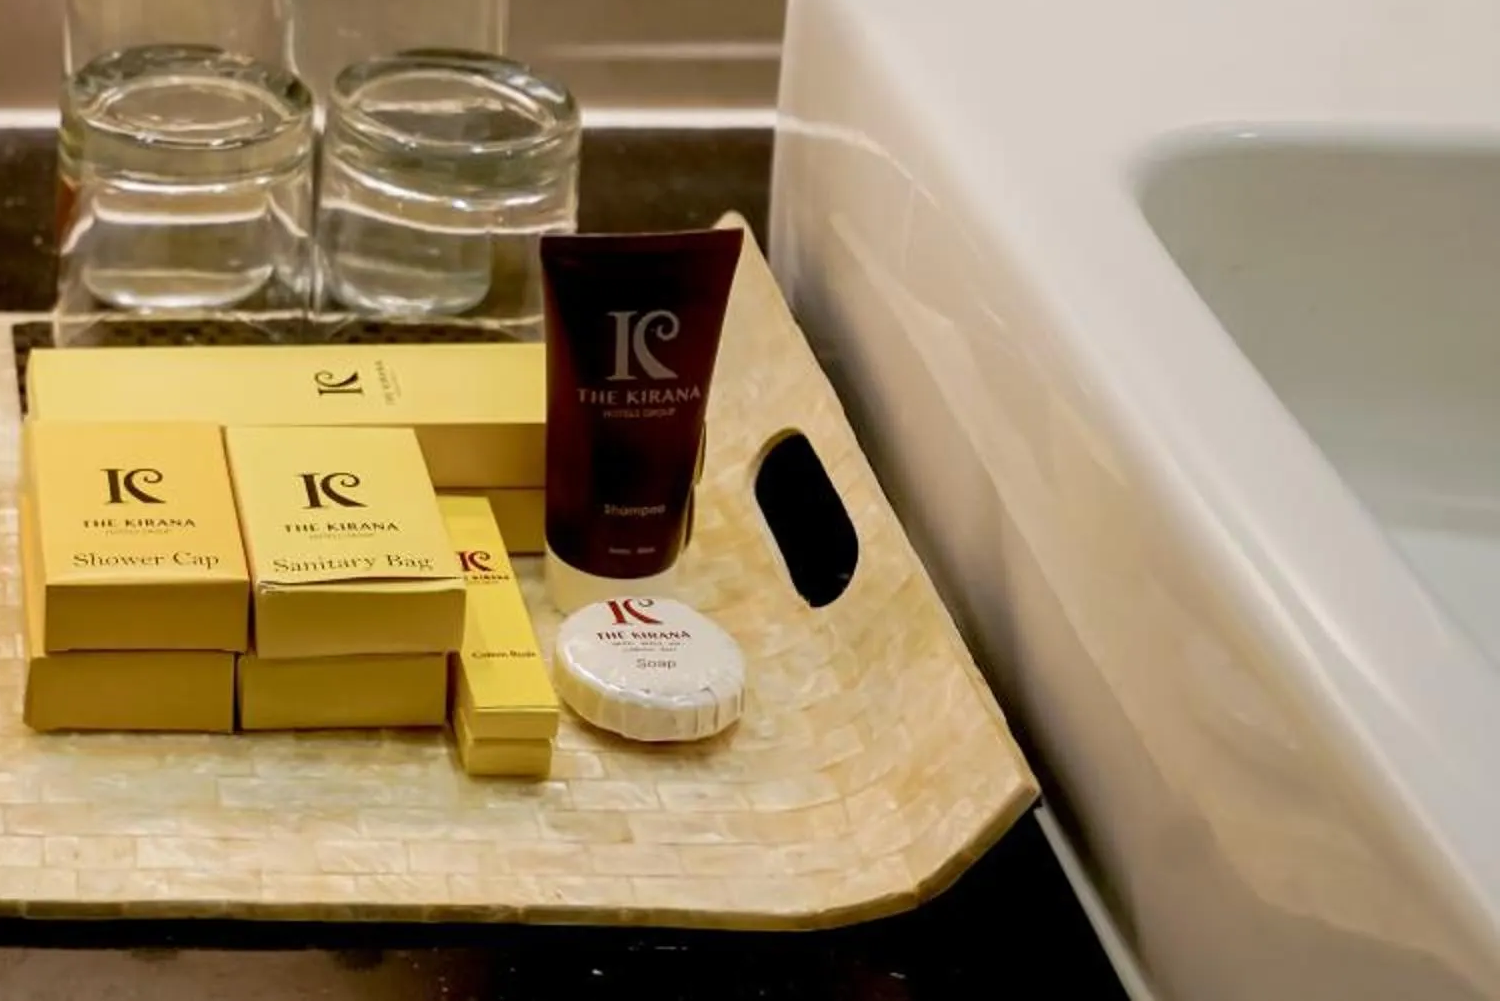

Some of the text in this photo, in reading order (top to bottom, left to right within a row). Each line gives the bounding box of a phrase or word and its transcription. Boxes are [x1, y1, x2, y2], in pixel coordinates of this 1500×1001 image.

[577, 384, 701, 405] THE KIRANA
[83, 518, 197, 529] THE KIRANA
[284, 521, 401, 533] THE KIRANA
[73, 551, 220, 570] Shower Cap
[273, 554, 435, 572] Sanitary Bag
[597, 630, 691, 640] THE KIRANA
[636, 658, 676, 670] Soap
